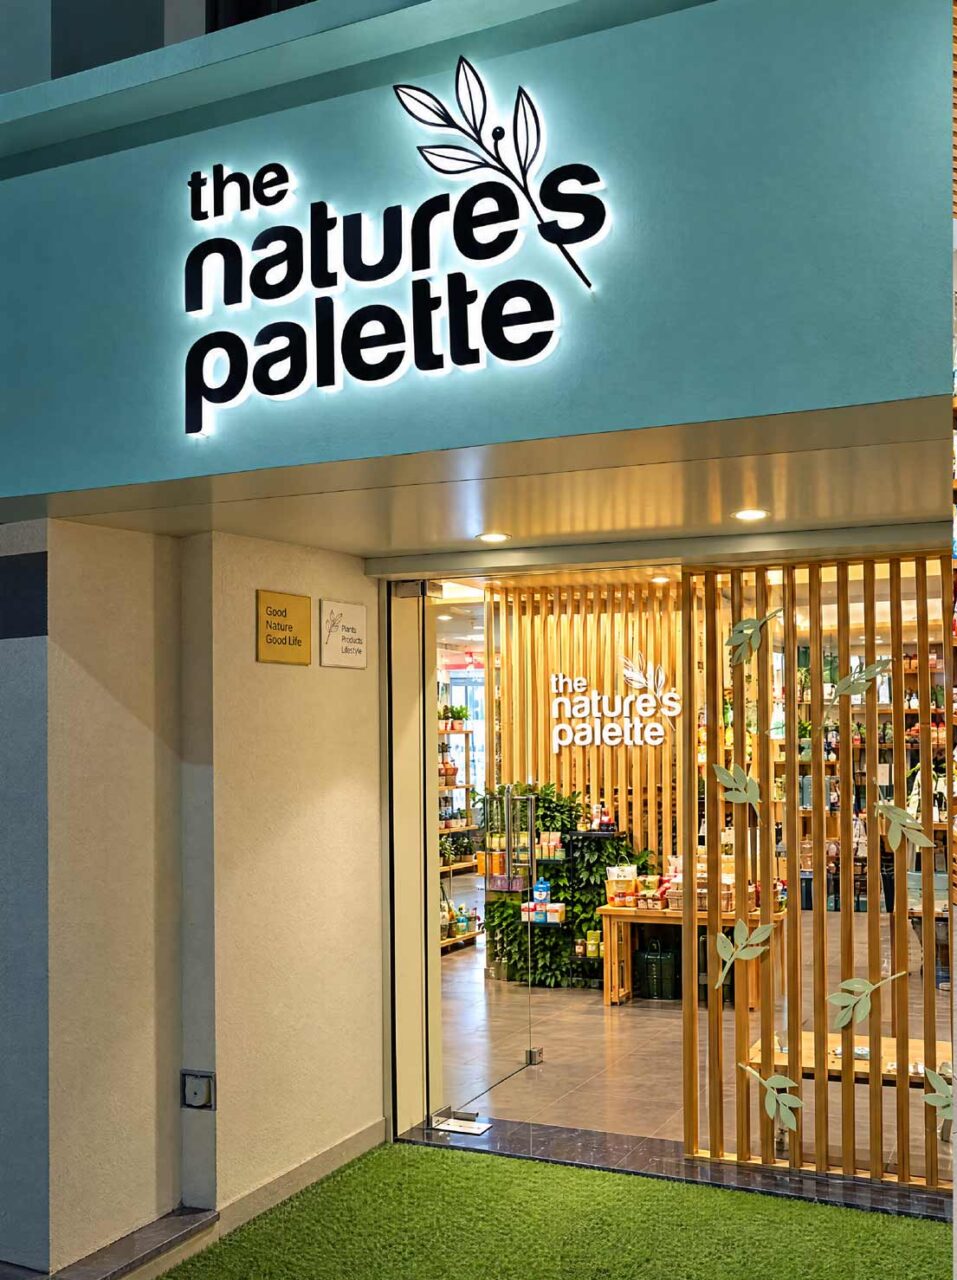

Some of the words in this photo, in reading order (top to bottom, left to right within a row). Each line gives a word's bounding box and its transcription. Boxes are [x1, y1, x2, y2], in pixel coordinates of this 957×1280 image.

[187, 162, 290, 221] the
[184, 271, 555, 435] palette
[265, 606, 287, 618] Good
[265, 620, 293, 632] Nature
[341, 624, 357, 634] Plants
[265, 633, 287, 645] Good
[288, 636, 303, 647] Life
[341, 636, 363, 646] Products
[341, 646, 362, 655] Lifestyle
[550, 672, 588, 694] the
[552, 715, 666, 754] palette
